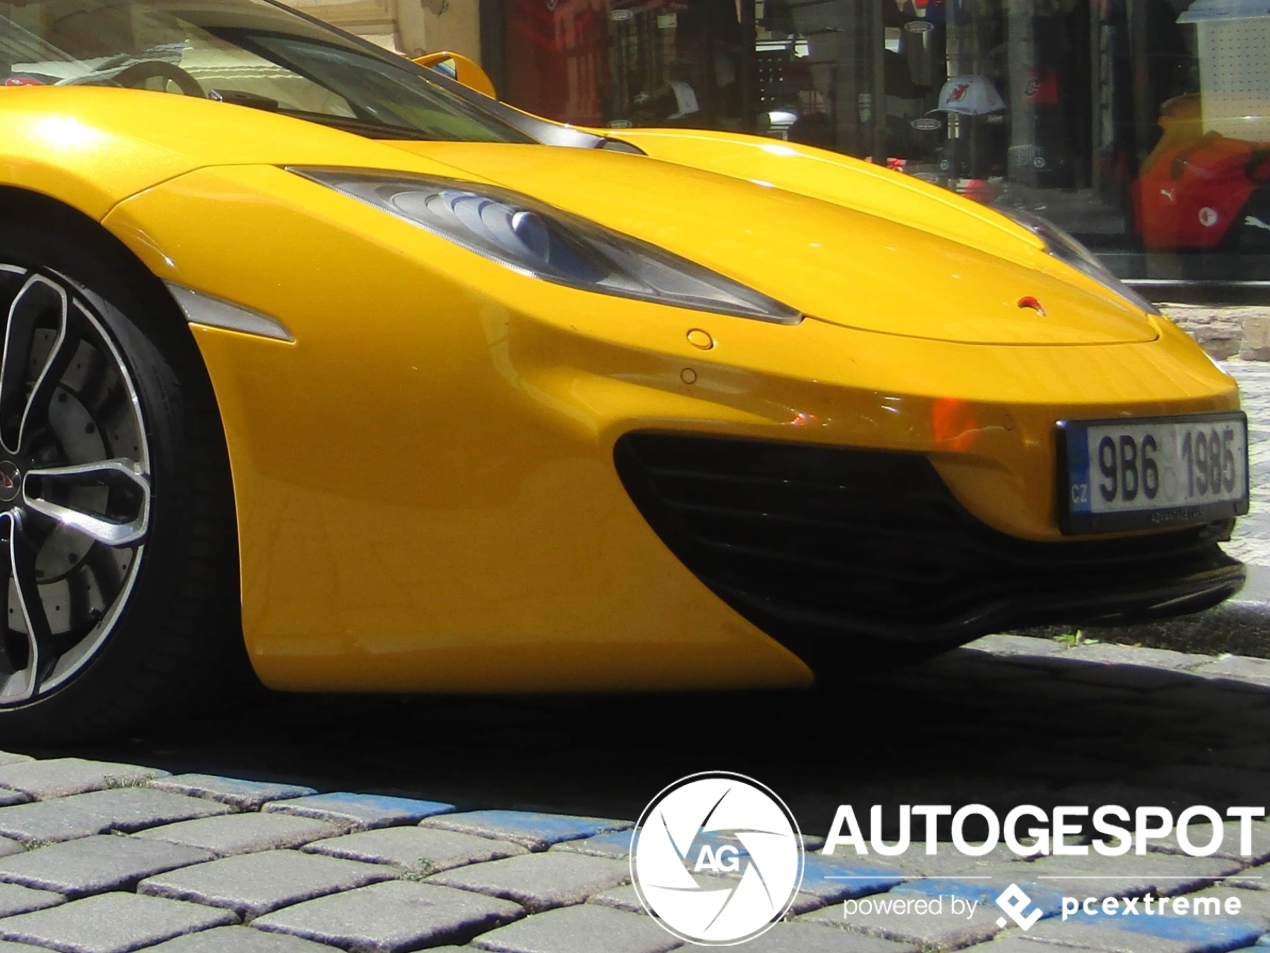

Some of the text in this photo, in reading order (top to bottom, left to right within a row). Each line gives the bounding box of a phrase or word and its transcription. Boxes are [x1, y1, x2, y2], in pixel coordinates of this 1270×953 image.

[1098, 427, 1237, 502] 9B6 1985
[1071, 483, 1088, 503] CZ
